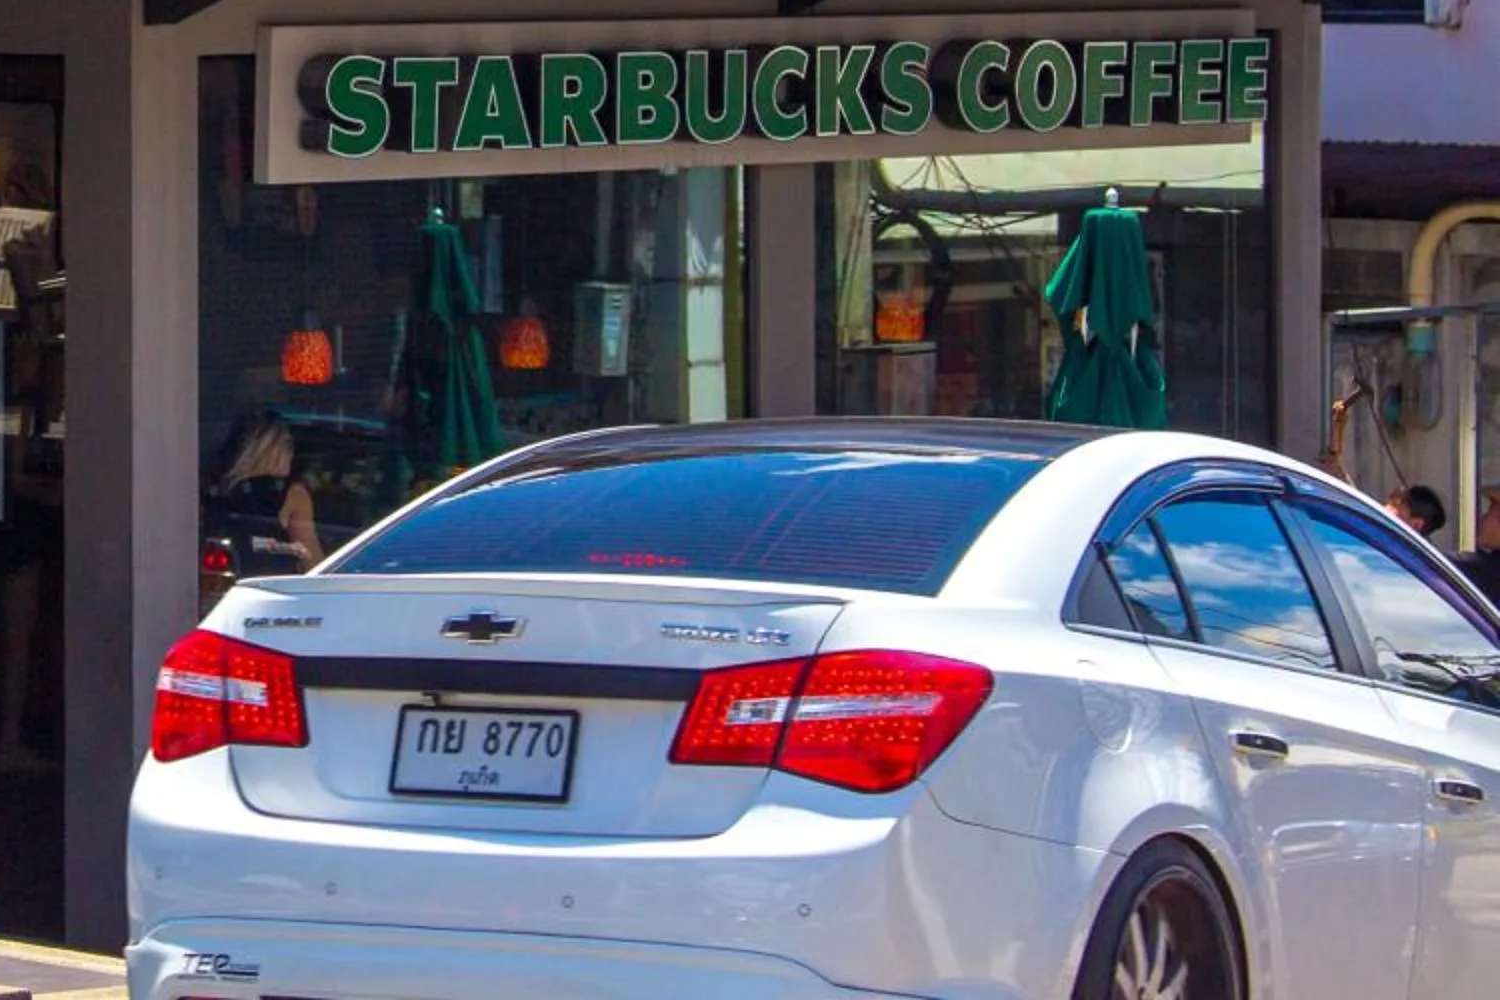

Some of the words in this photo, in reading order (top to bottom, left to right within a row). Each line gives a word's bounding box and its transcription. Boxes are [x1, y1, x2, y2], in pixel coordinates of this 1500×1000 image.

[325, 40, 934, 159] STARBUCKS
[956, 37, 1271, 133] COFFEE
[482, 720, 565, 759] 8770
